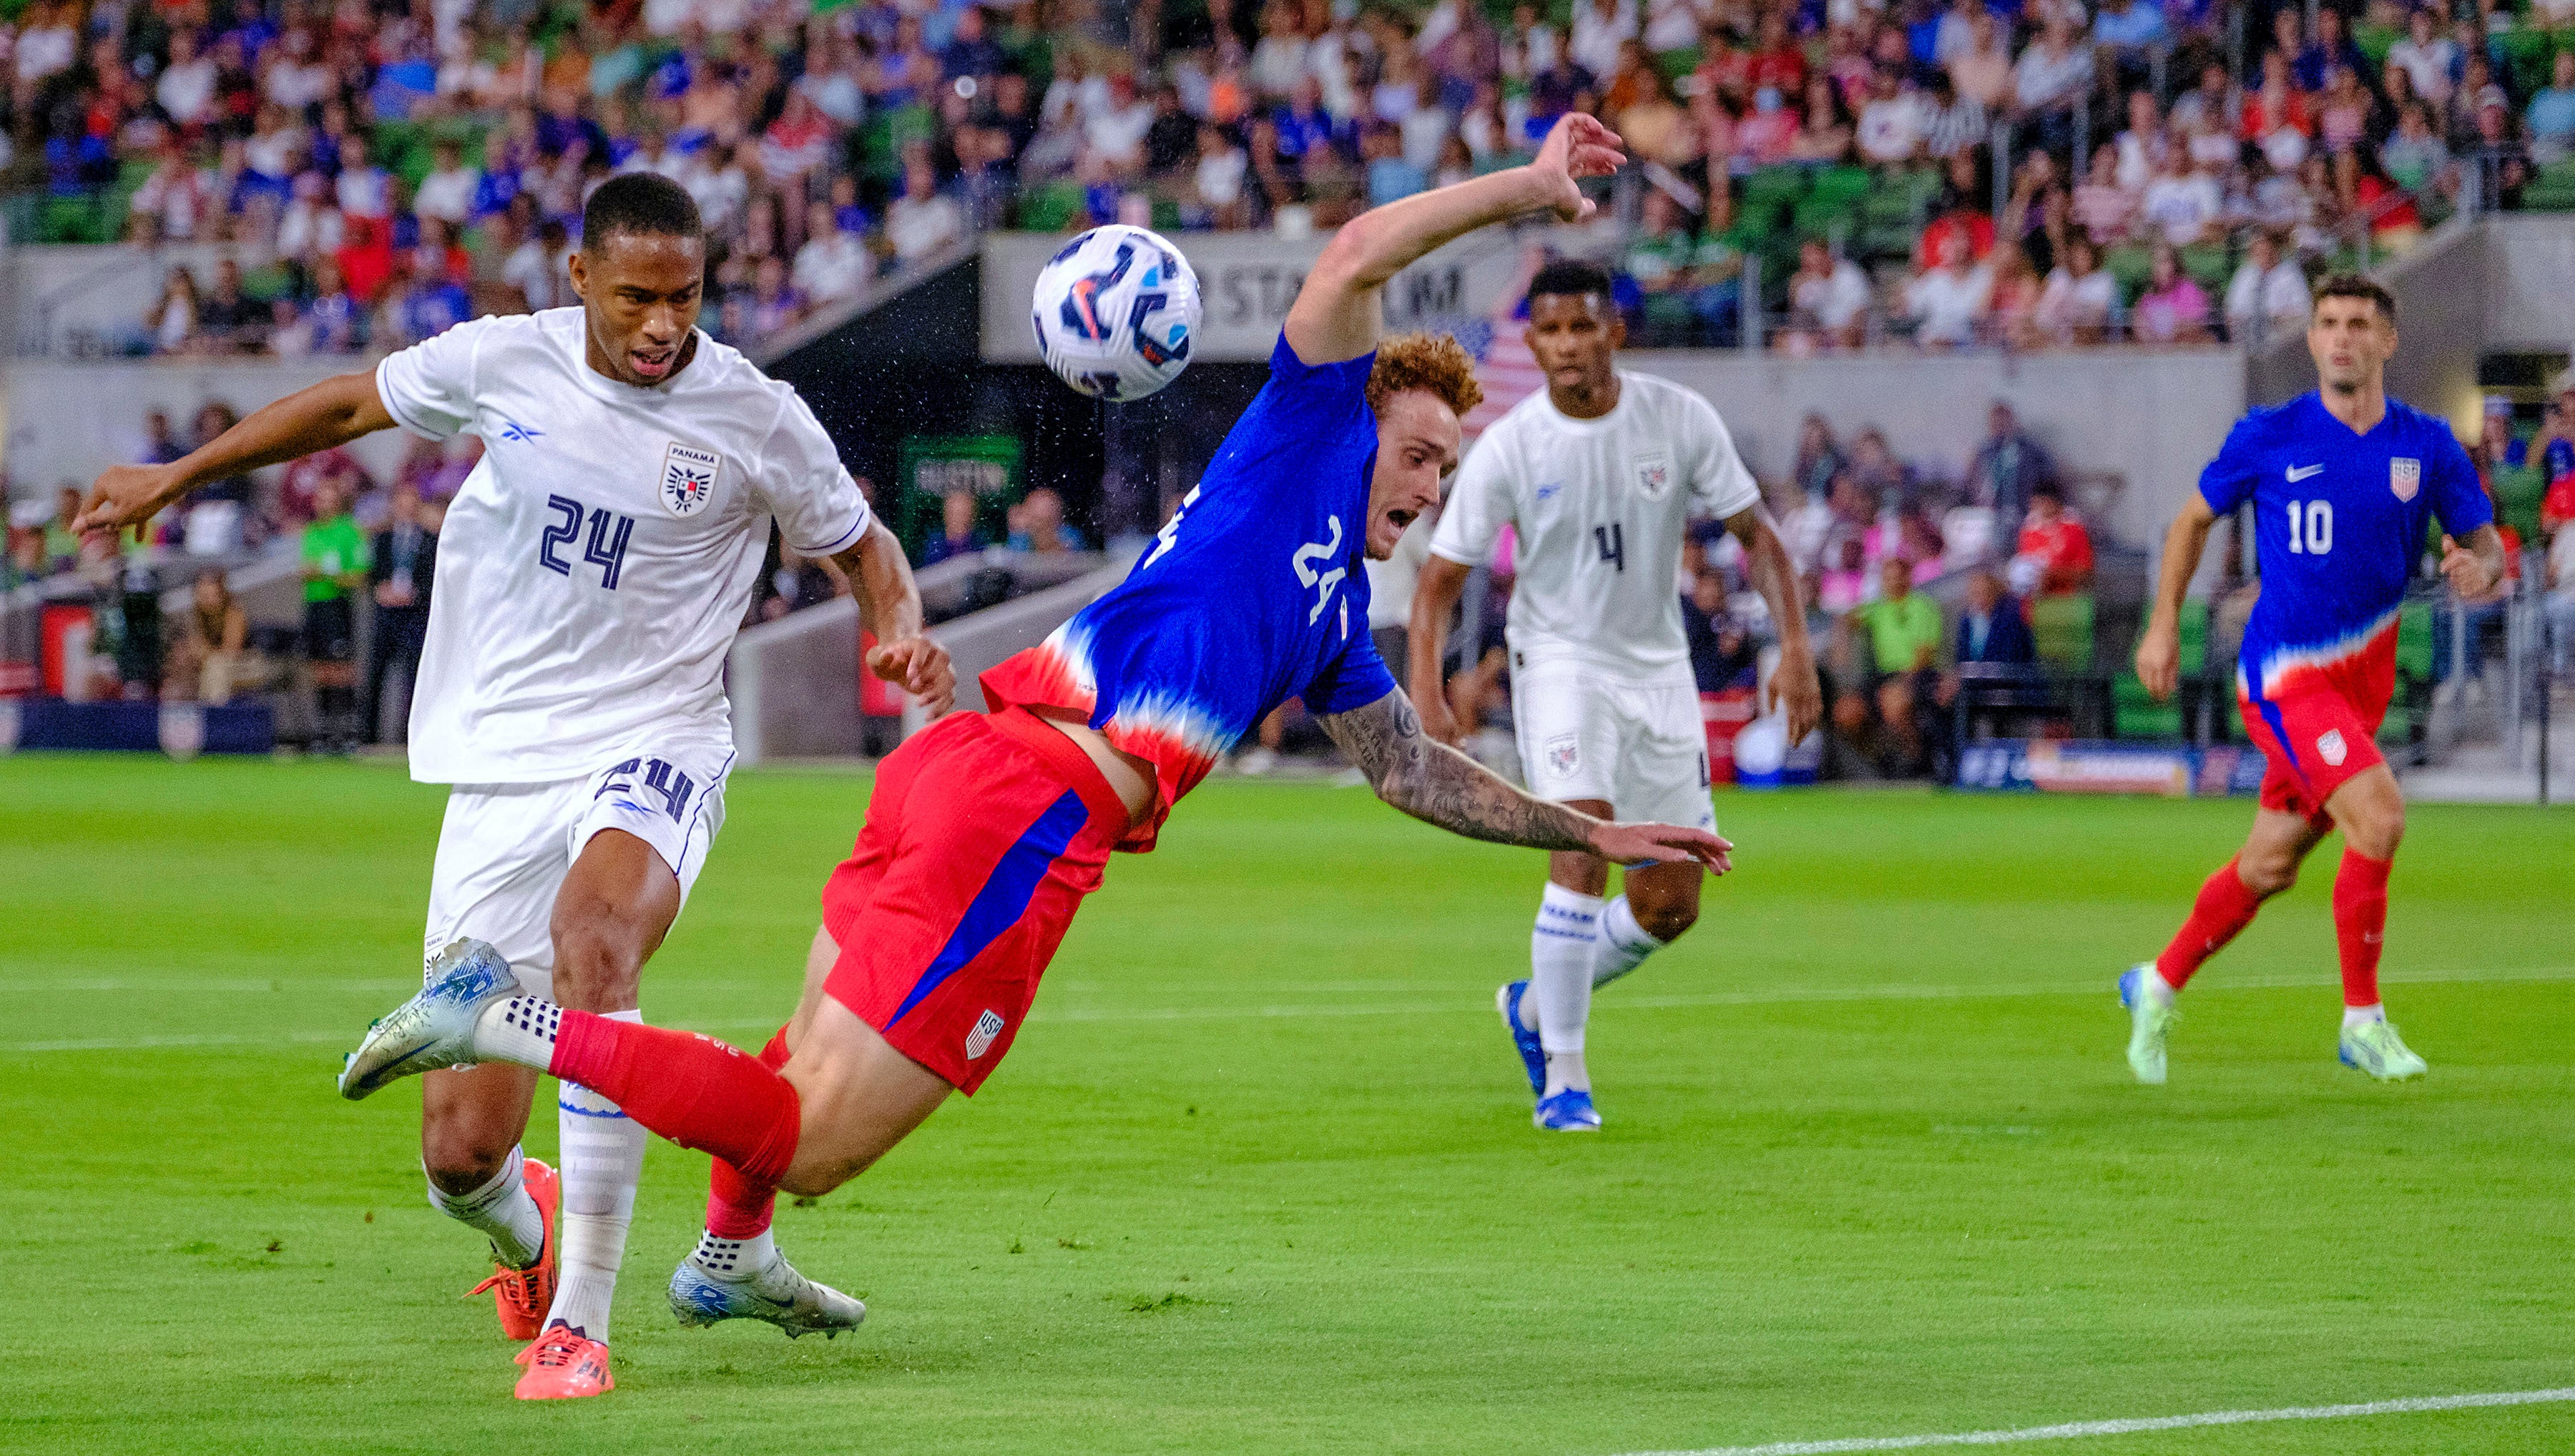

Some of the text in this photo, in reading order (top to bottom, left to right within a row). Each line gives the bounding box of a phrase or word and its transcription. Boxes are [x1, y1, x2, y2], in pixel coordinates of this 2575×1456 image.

[1223, 265, 1461, 328] STUM
[672, 448, 715, 463] PANAMA
[540, 493, 634, 591] 24
[1595, 523, 1624, 571] 4
[2286, 500, 2333, 555] 10
[1293, 514, 1345, 626] 24
[594, 757, 695, 825] 24
[981, 1013, 1002, 1035] USA
